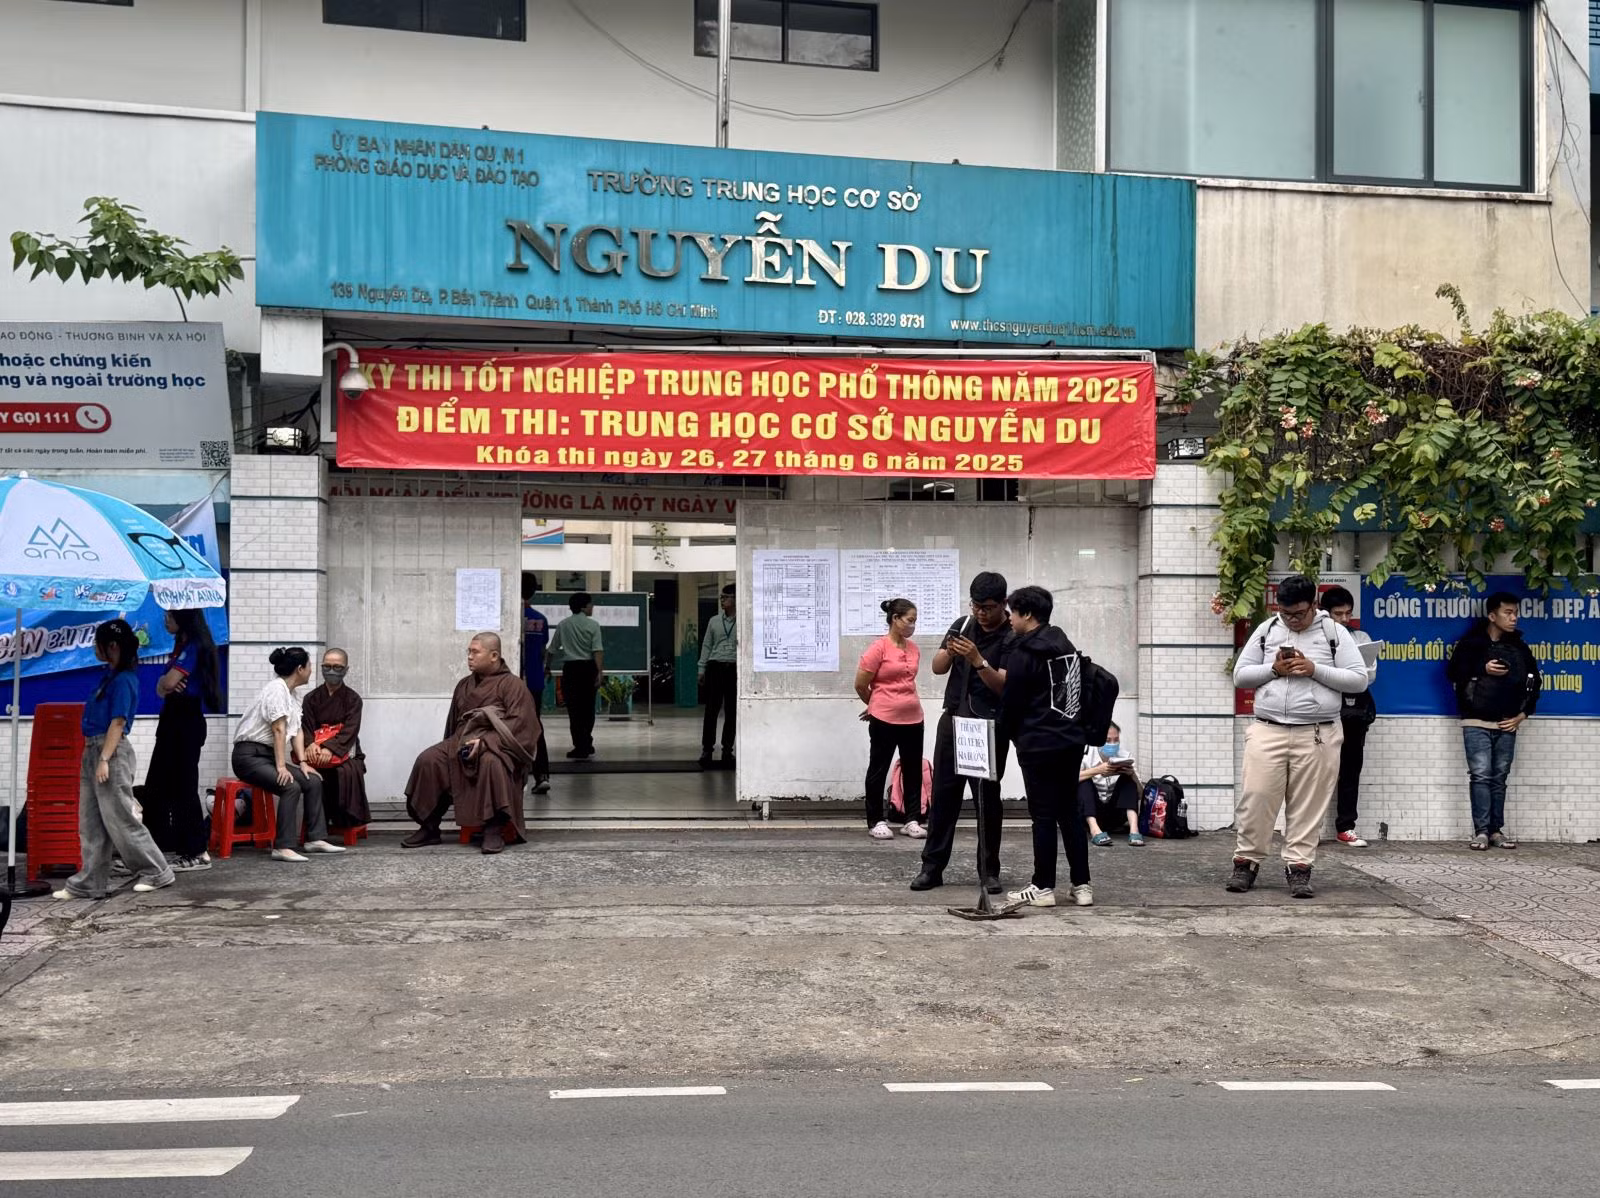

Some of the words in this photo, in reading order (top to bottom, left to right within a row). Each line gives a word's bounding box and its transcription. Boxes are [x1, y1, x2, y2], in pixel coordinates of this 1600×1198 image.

[395, 137, 436, 159] NHÂN
[440, 139, 470, 161] DÂN
[475, 145, 514, 165] QUN
[518, 148, 525, 165] 1
[314, 153, 370, 174] PHÒNG
[374, 158, 413, 179] GIÁO
[417, 163, 448, 183] DỤC
[475, 164, 507, 184] ĐÀO
[511, 169, 540, 190] TẠO
[588, 168, 693, 197] TRƯỜNG
[702, 178, 781, 203] TRUNG
[787, 184, 836, 211] HỌC
[844, 188, 880, 208] CƠ
[887, 185, 922, 212] SỞ
[505, 209, 853, 289] NGUYỄN
[877, 243, 991, 295] DU
[330, 281, 354, 298] 139
[526, 294, 560, 314] Quận
[845, 311, 897, 328] 028.3829
[900, 314, 925, 329] 8731
[118, 332, 145, 342] BINH
[50, 353, 107, 370] chứng
[111, 353, 152, 368] kiến
[25, 372, 47, 386] và
[51, 373, 101, 389] ngoài
[107, 372, 168, 390] trường
[172, 373, 206, 390] học
[404, 364, 452, 391] THI
[461, 358, 515, 393] TỐT
[523, 363, 636, 400] NGHIỆP
[643, 369, 743, 397] TRUNG
[751, 371, 810, 403] HỌC
[819, 363, 879, 399] PHỔ
[886, 369, 983, 401] THÔNG
[992, 371, 1059, 403] NĂM
[1067, 377, 1139, 404] 2025
[12, 412, 41, 426] GỌI
[44, 412, 70, 424] 111
[396, 396, 490, 434] ĐIỂM
[501, 408, 570, 436] THI:
[580, 409, 699, 438] TRUNG
[709, 411, 780, 444] HỌC
[791, 411, 838, 441] CƠ
[847, 406, 894, 442] SỞ
[903, 407, 1046, 444] NGUYỄN
[1056, 417, 1102, 444] DU
[477, 445, 550, 465] Khóa
[558, 447, 596, 466] thi
[604, 448, 673, 469] ngày
[681, 449, 724, 470] 26,
[733, 450, 767, 468] 27
[774, 449, 854, 472] tháng
[862, 451, 879, 470] 6
[886, 452, 947, 471] năm
[955, 454, 1024, 473] 2025
[580, 491, 605, 510] LÀ
[612, 492, 655, 516] MỘT
[662, 494, 718, 513] NGÀY
[24, 547, 100, 563] anna
[198, 590, 224, 603] ANNA
[1373, 591, 1421, 618] CỔNG
[1552, 598, 1586, 623] ĐẸP,
[1378, 637, 1422, 662] Chuyển
[1425, 637, 1445, 661] đổi
[1528, 640, 1552, 665] một
[1554, 640, 1580, 663] giáo
[1553, 670, 1583, 693] vững
